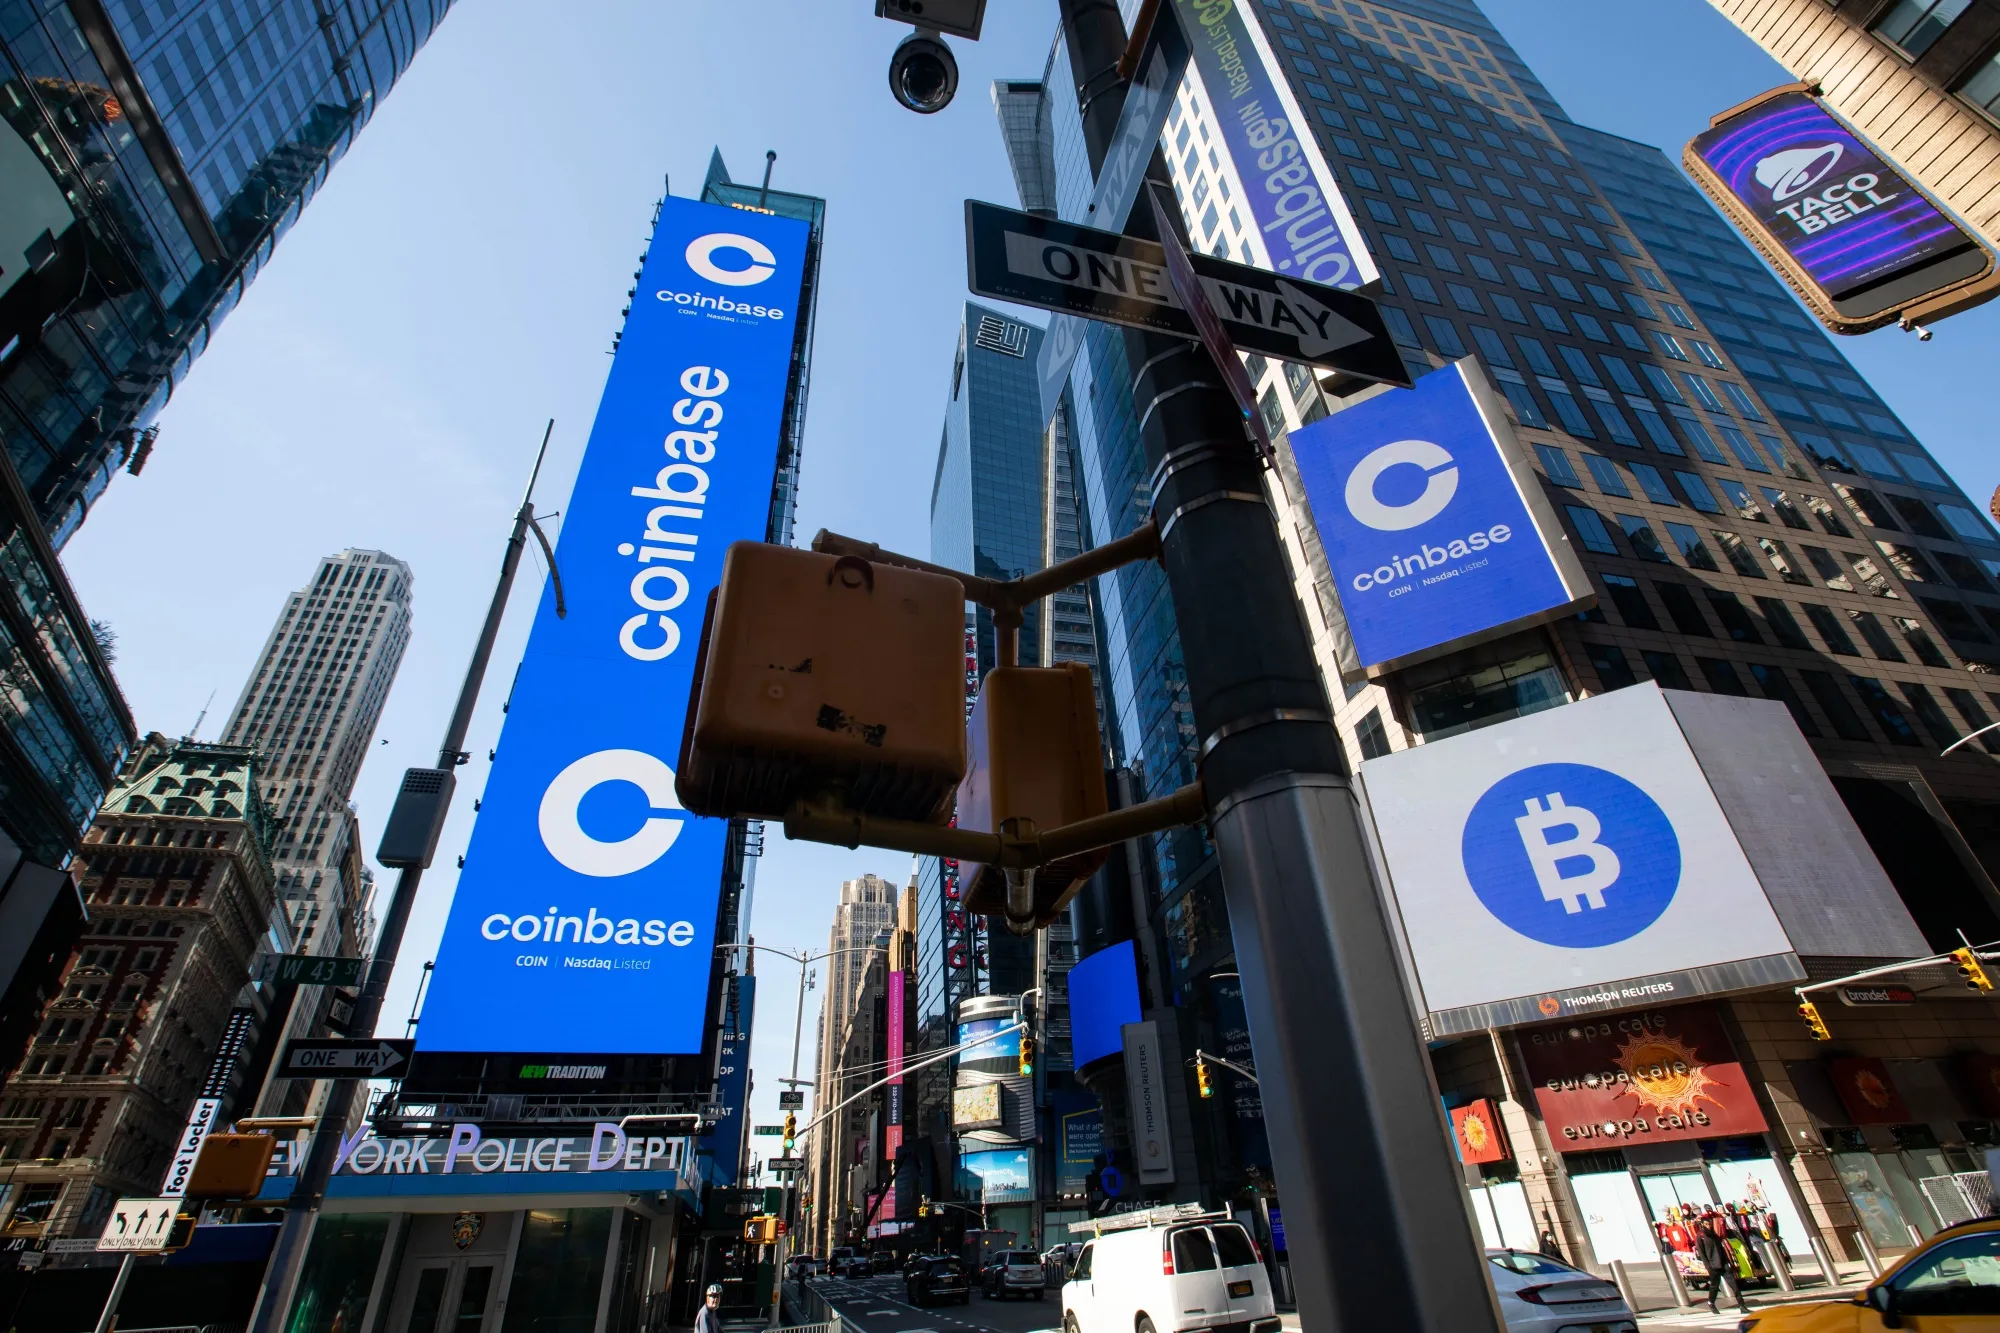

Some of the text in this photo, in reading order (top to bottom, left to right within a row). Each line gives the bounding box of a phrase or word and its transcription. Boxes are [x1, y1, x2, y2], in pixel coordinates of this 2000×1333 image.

[1248, 117, 1358, 290] oinbase
[1776, 173, 1879, 221] TACO
[1797, 190, 1899, 235] BELL
[656, 289, 784, 320] coinbase
[1042, 246, 1331, 340] ONE WAY
[678, 308, 759, 326] COIN Nasdaq Listed
[617, 365, 730, 661] coinbase
[1353, 524, 1512, 592] coinbase
[1388, 557, 1489, 598] COIN Nasdaq Listed
[481, 906, 694, 947] coinbase
[282, 959, 360, 981] W 43 St
[516, 955, 651, 971] COIN Nasdaq Listed
[1564, 982, 1674, 1008] THOMSON REUTERS
[203, 1058, 224, 1096] BECAUSE
[214, 1058, 235, 1096] BECAUSE
[301, 1051, 394, 1067] ONE WAY
[1138, 1043, 1156, 1135] THOMSON REUTERS
[166, 1102, 214, 1193] Foot Locker
[331, 1124, 431, 1175] YORK
[443, 1123, 574, 1174] POLICE
[587, 1122, 685, 1172] DEPT
[102, 1238, 121, 1246] ONLY
[122, 1238, 142, 1246] ONLY
[143, 1238, 163, 1246] ONLY
